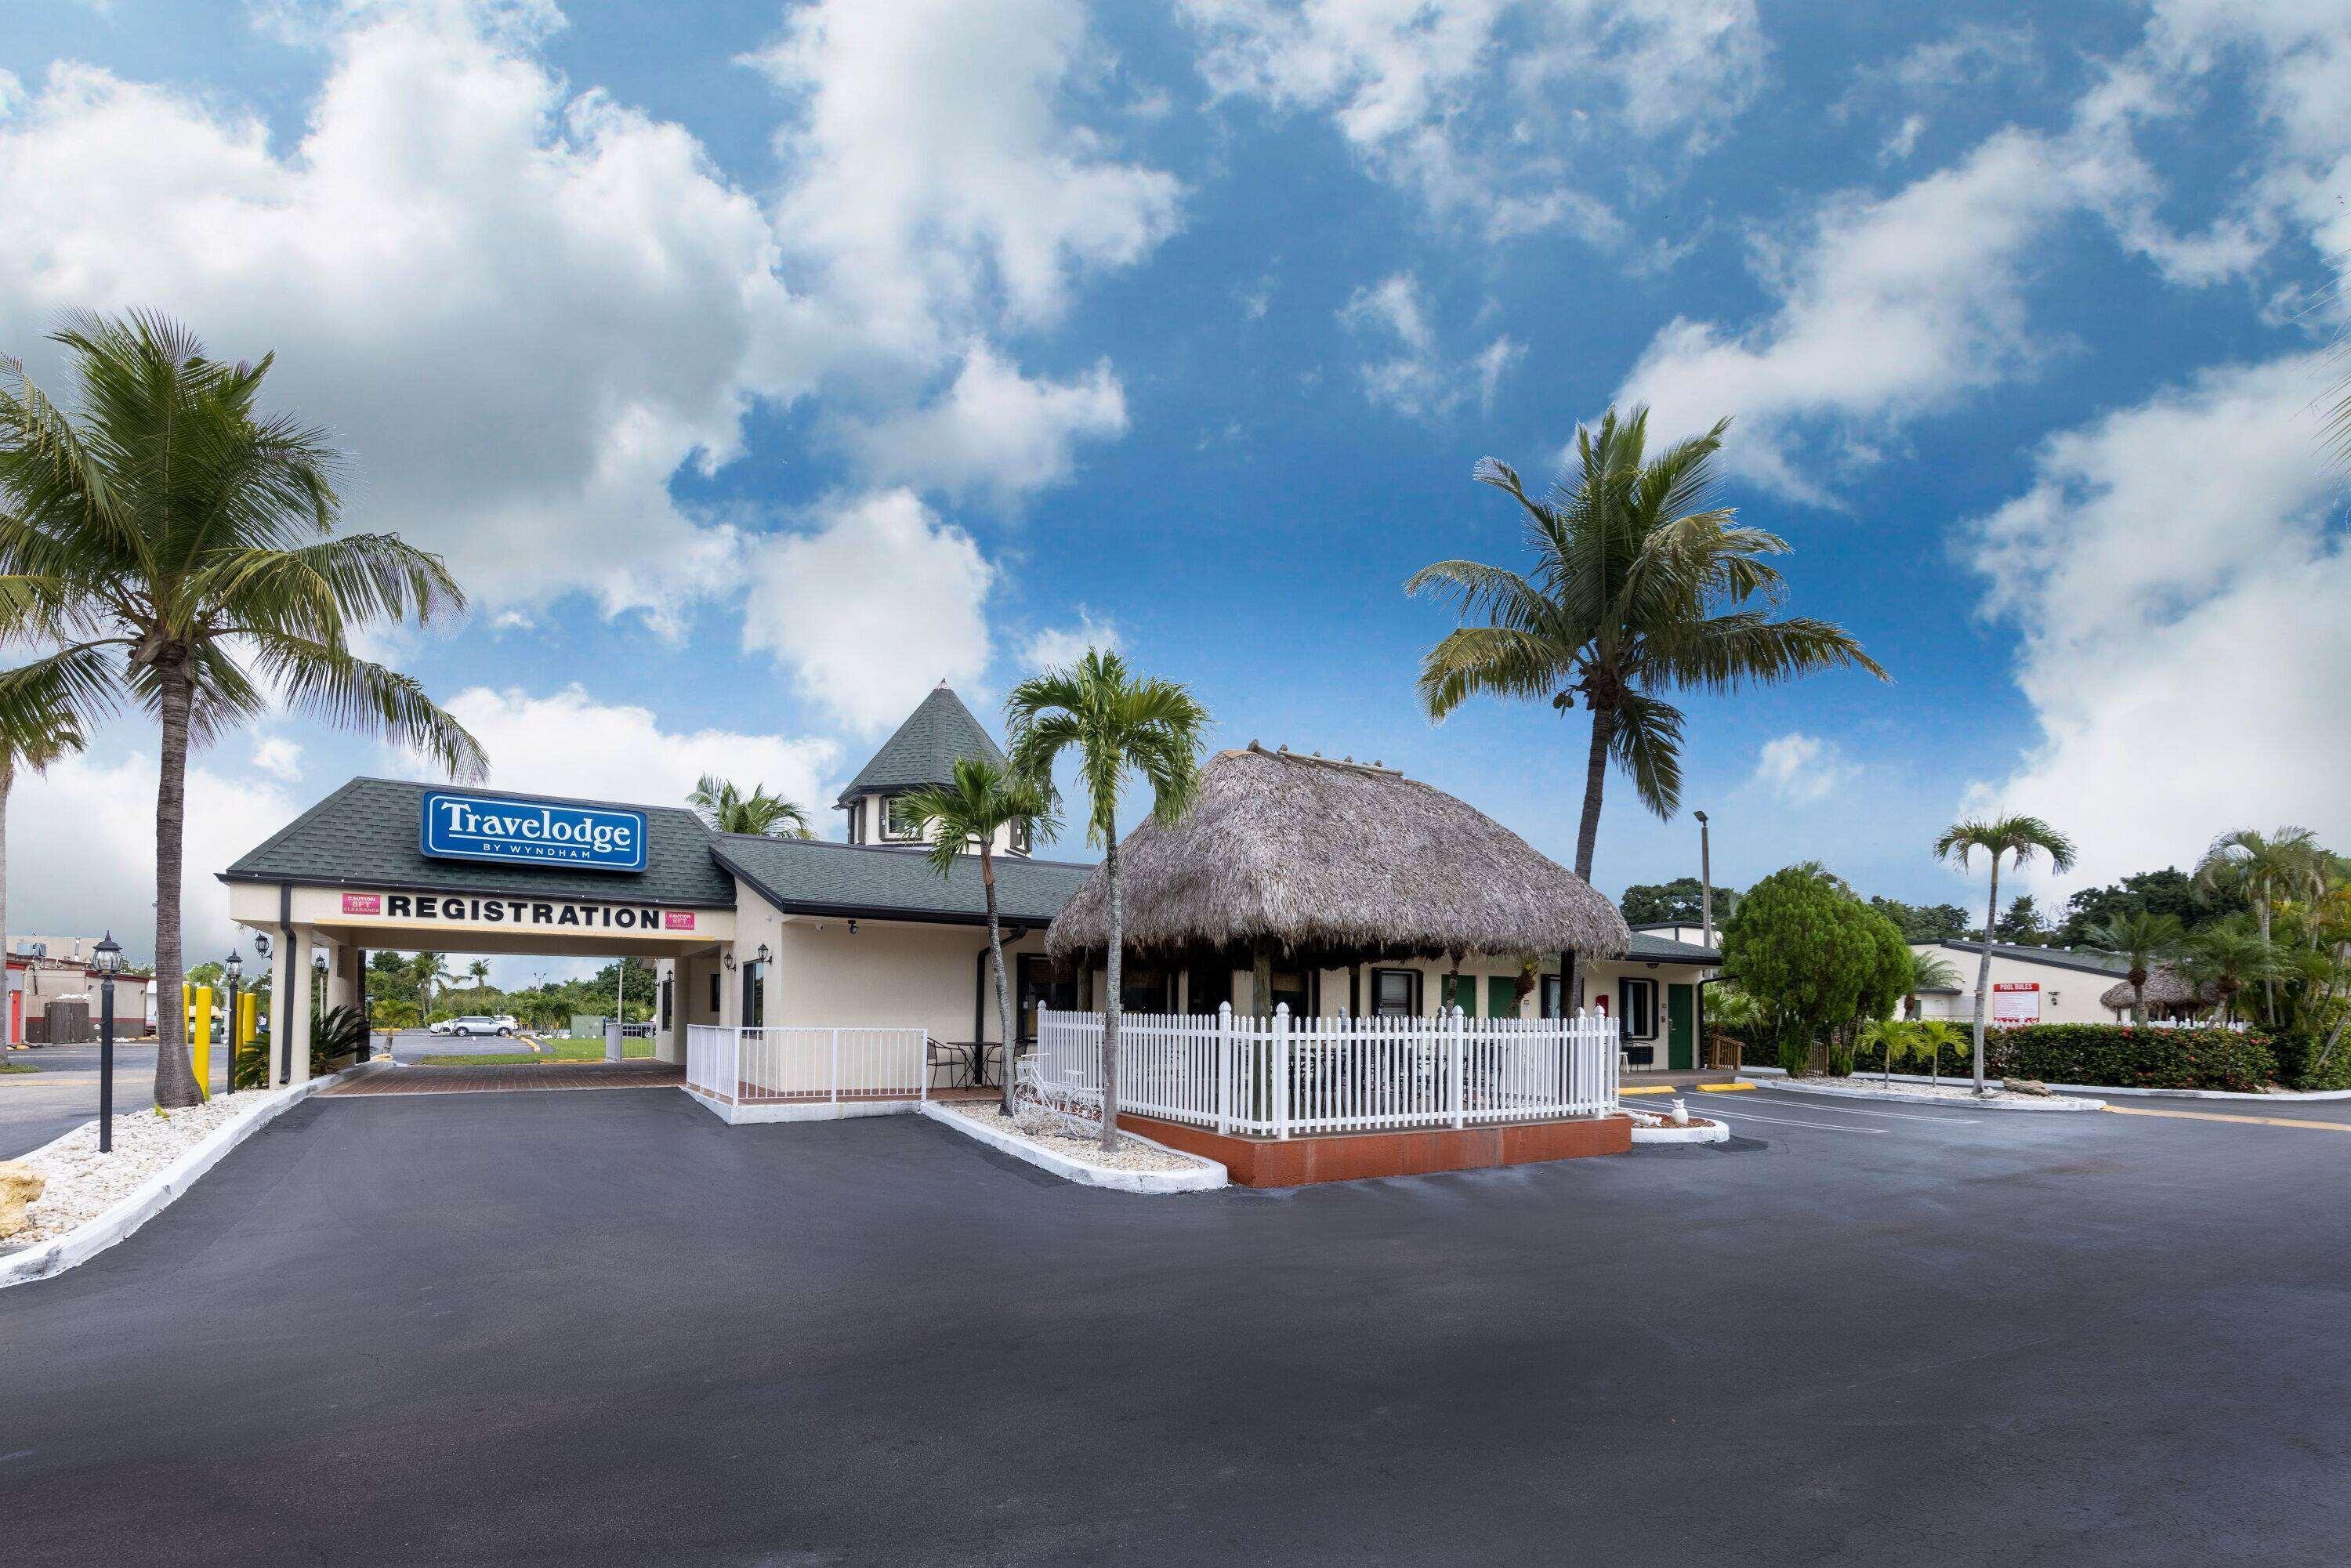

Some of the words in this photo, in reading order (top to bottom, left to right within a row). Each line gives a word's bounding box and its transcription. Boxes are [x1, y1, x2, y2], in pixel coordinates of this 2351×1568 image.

[441, 802, 631, 853] Travelodge
[483, 843, 501, 852] BY
[510, 846, 590, 858] WYNDHAM
[388, 895, 660, 929] REGISTRATION
